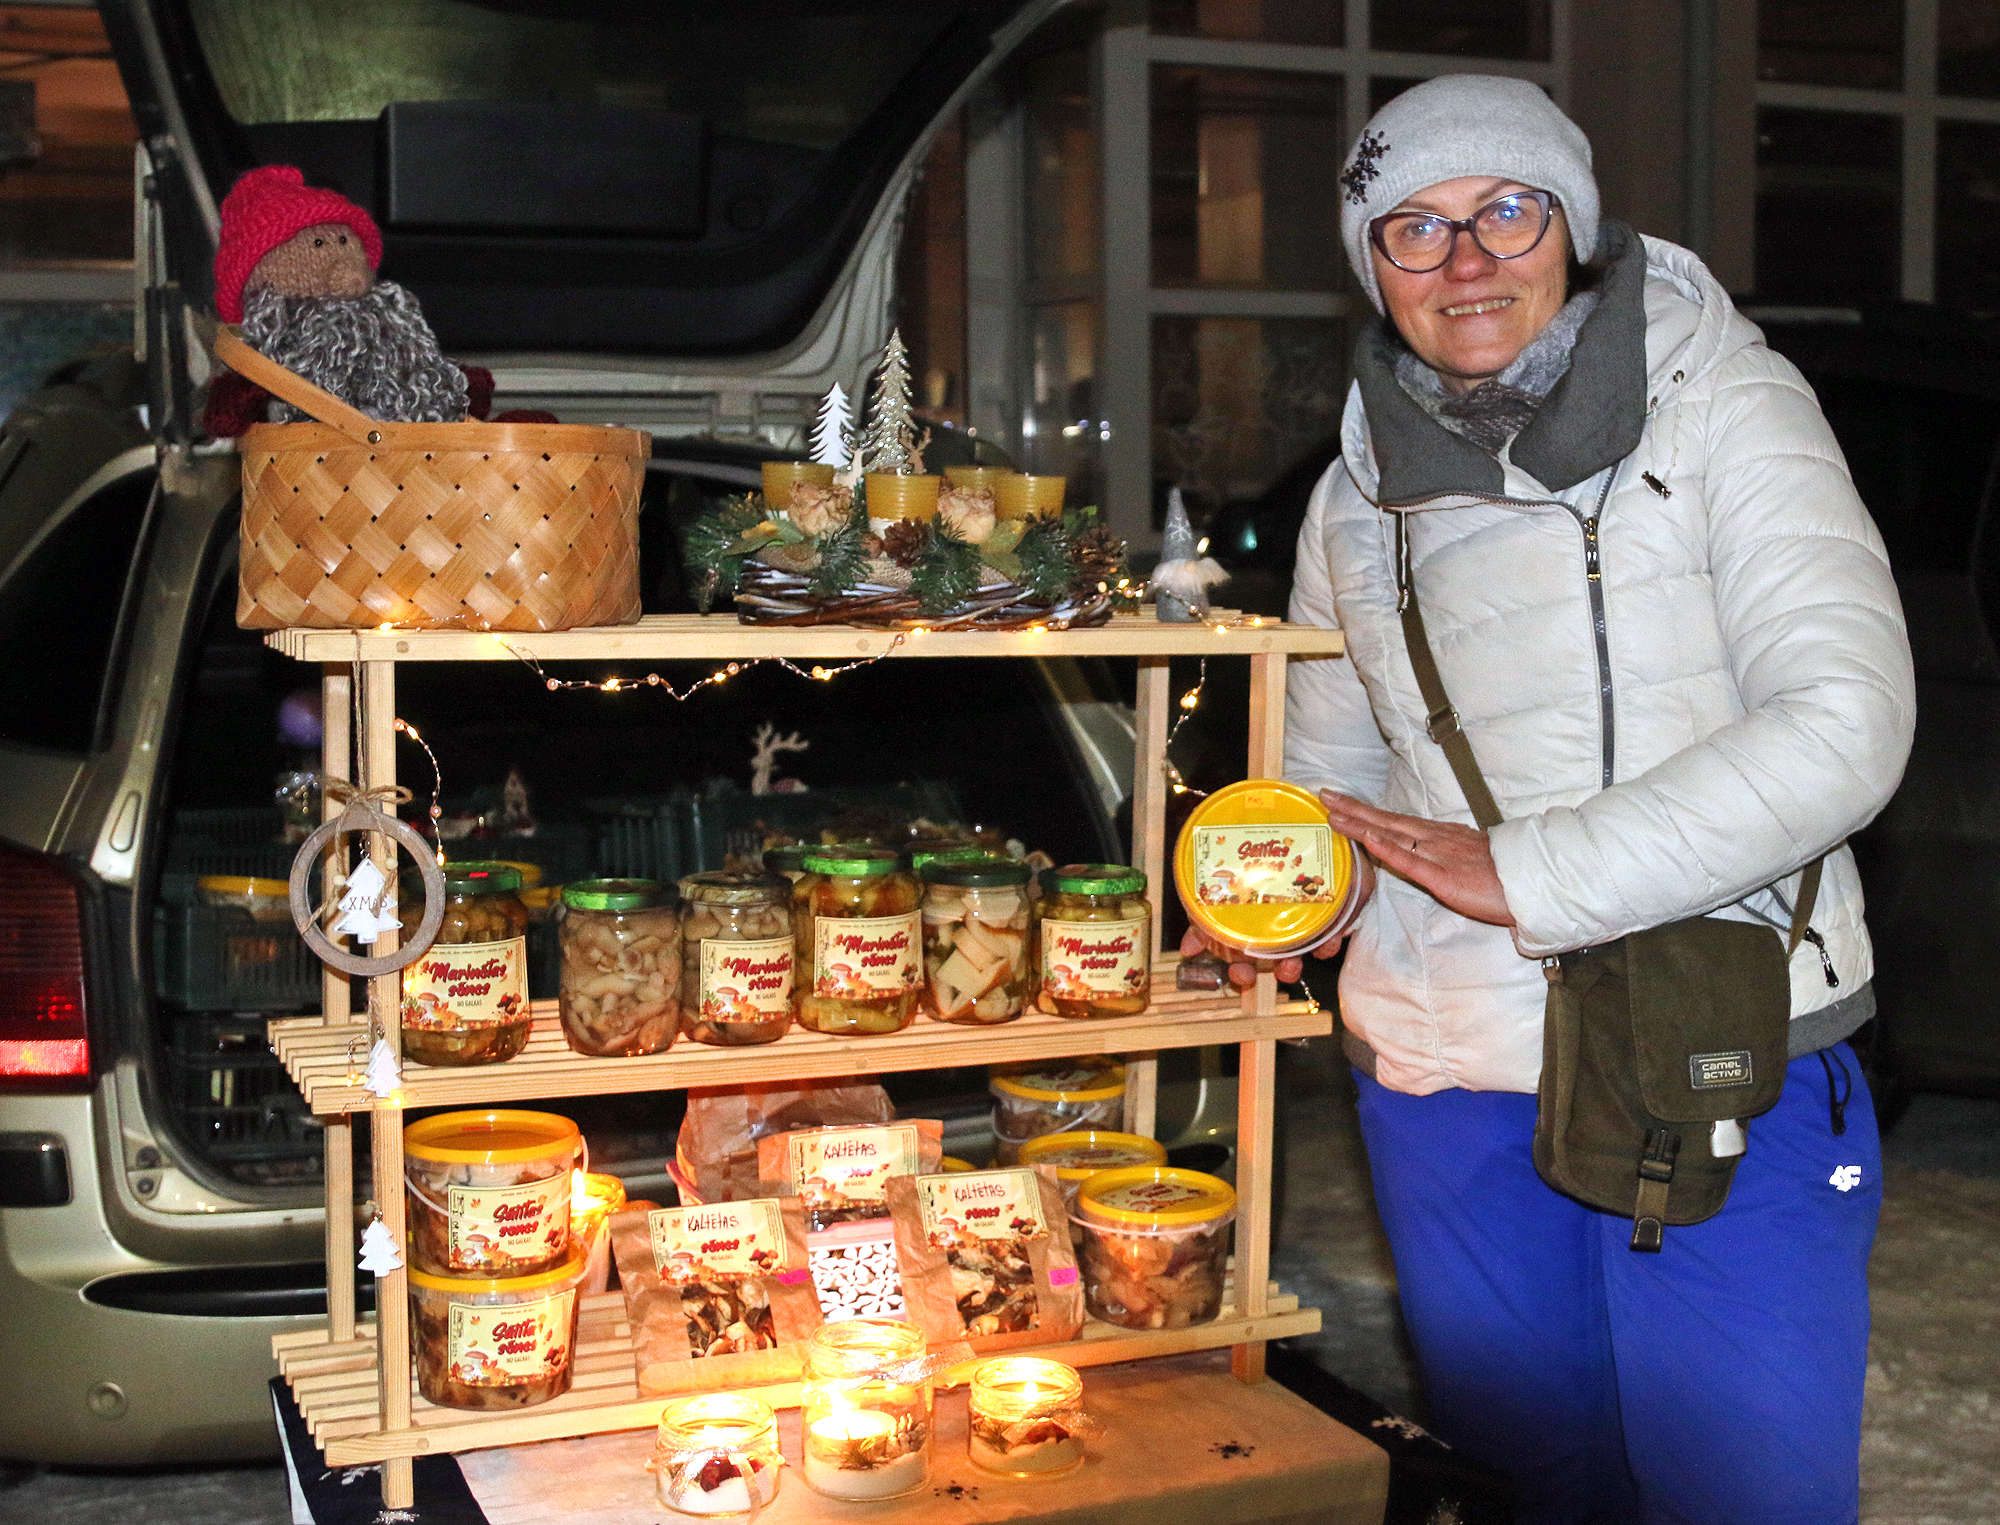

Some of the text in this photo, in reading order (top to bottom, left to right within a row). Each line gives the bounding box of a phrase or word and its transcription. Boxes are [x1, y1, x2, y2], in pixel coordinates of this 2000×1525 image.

[429, 958, 507, 983] Marinētas
[448, 982, 491, 997] sēnes
[1702, 1060, 1741, 1071] camel
[1703, 1069, 1742, 1080] active
